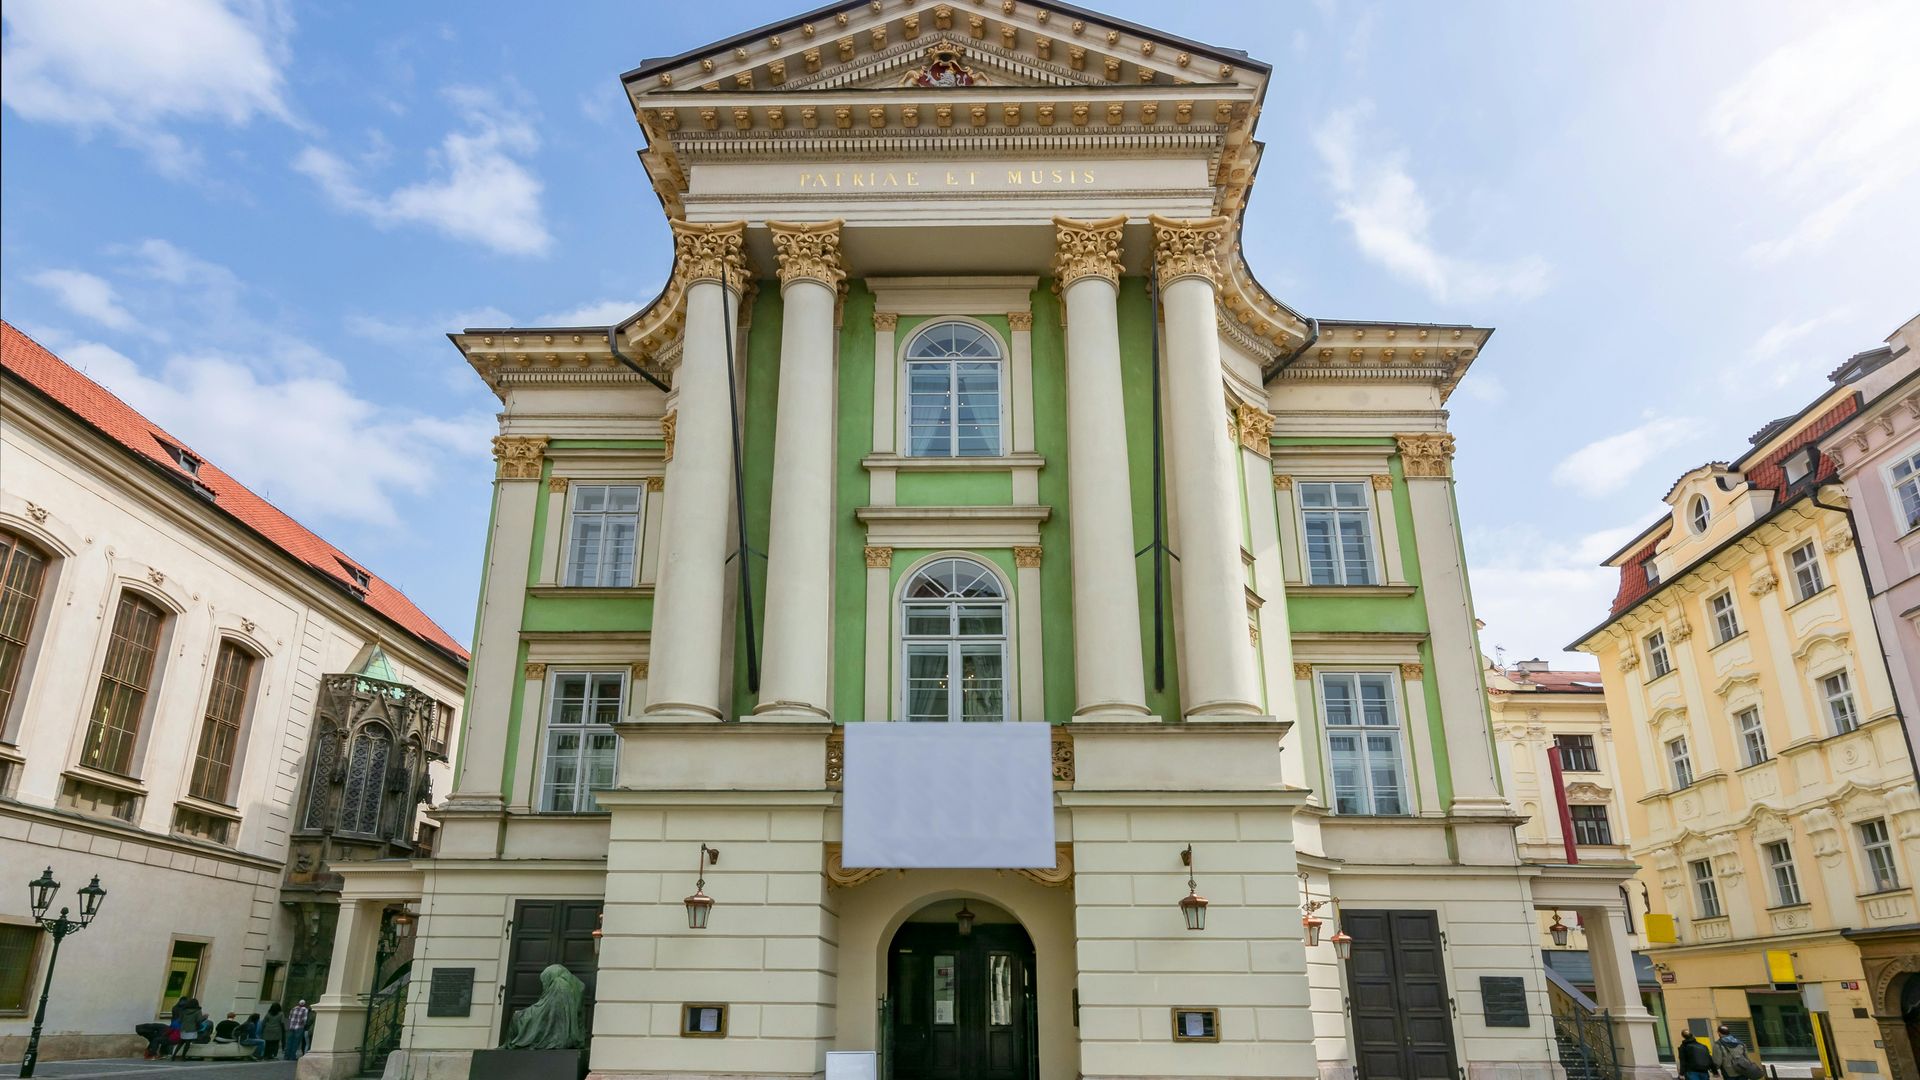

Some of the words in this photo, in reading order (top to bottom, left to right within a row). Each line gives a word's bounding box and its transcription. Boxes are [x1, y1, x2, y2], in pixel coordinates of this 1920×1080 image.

[800, 171, 920, 187] PATRIAE
[946, 170, 979, 186] ET
[1008, 169, 1095, 185] MUSIS
